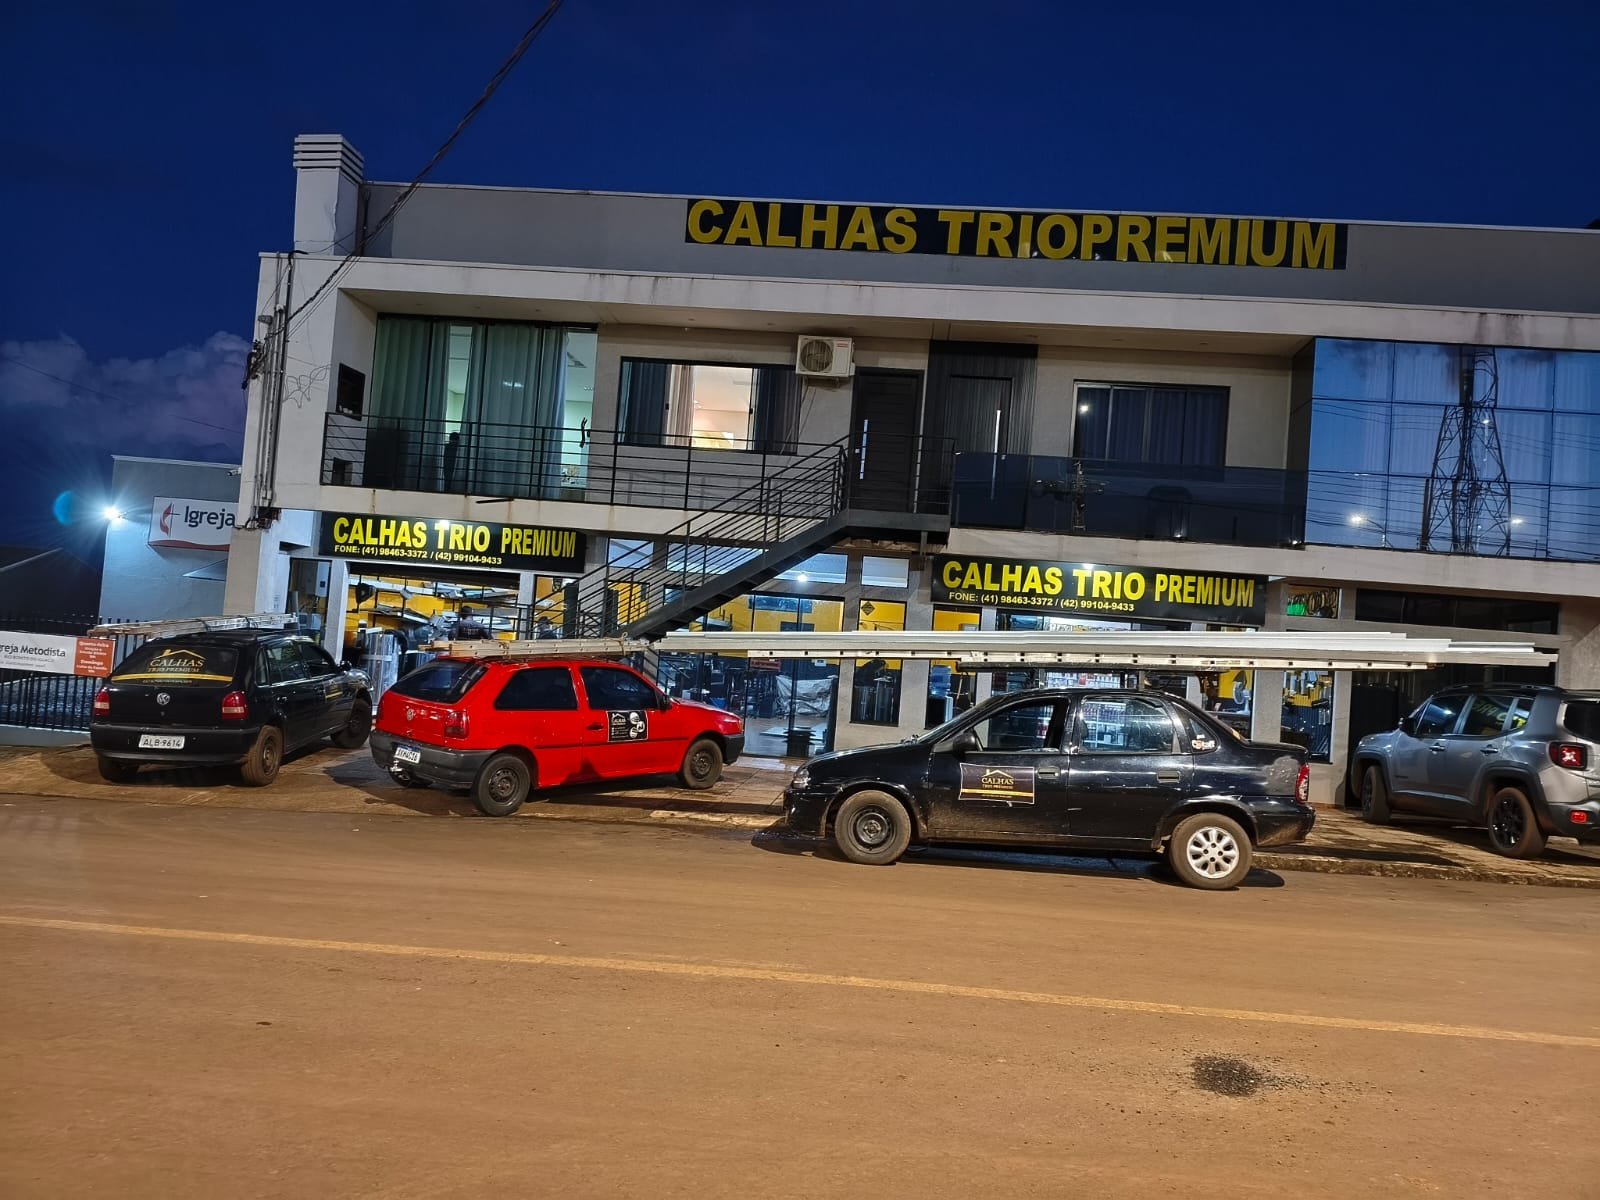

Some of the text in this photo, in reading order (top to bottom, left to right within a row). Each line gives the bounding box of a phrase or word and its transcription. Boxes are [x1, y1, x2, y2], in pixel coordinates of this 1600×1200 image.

[688, 199, 917, 253] CALHAS
[184, 505, 236, 530] Igreja
[333, 516, 577, 559] CALHAS TRIO PREMIUM
[334, 544, 361, 554] FONE:
[362, 546, 378, 556] (41)
[379, 547, 428, 559] 98463-3372
[435, 550, 452, 561] (42)
[453, 552, 502, 565] 99104-9433
[942, 560, 1255, 608] CALHAS TRIO PREMIUM
[949, 591, 979, 602] FONE:
[981, 593, 998, 604] (41)
[1000, 595, 1053, 607] 98463-3372
[1060, 598, 1078, 609] (42)
[1080, 600, 1135, 612] 99104-9433
[20, 645, 66, 657] Metodista
[150, 658, 204, 667] CALHAS
[981, 777, 1014, 785] CALHAS
